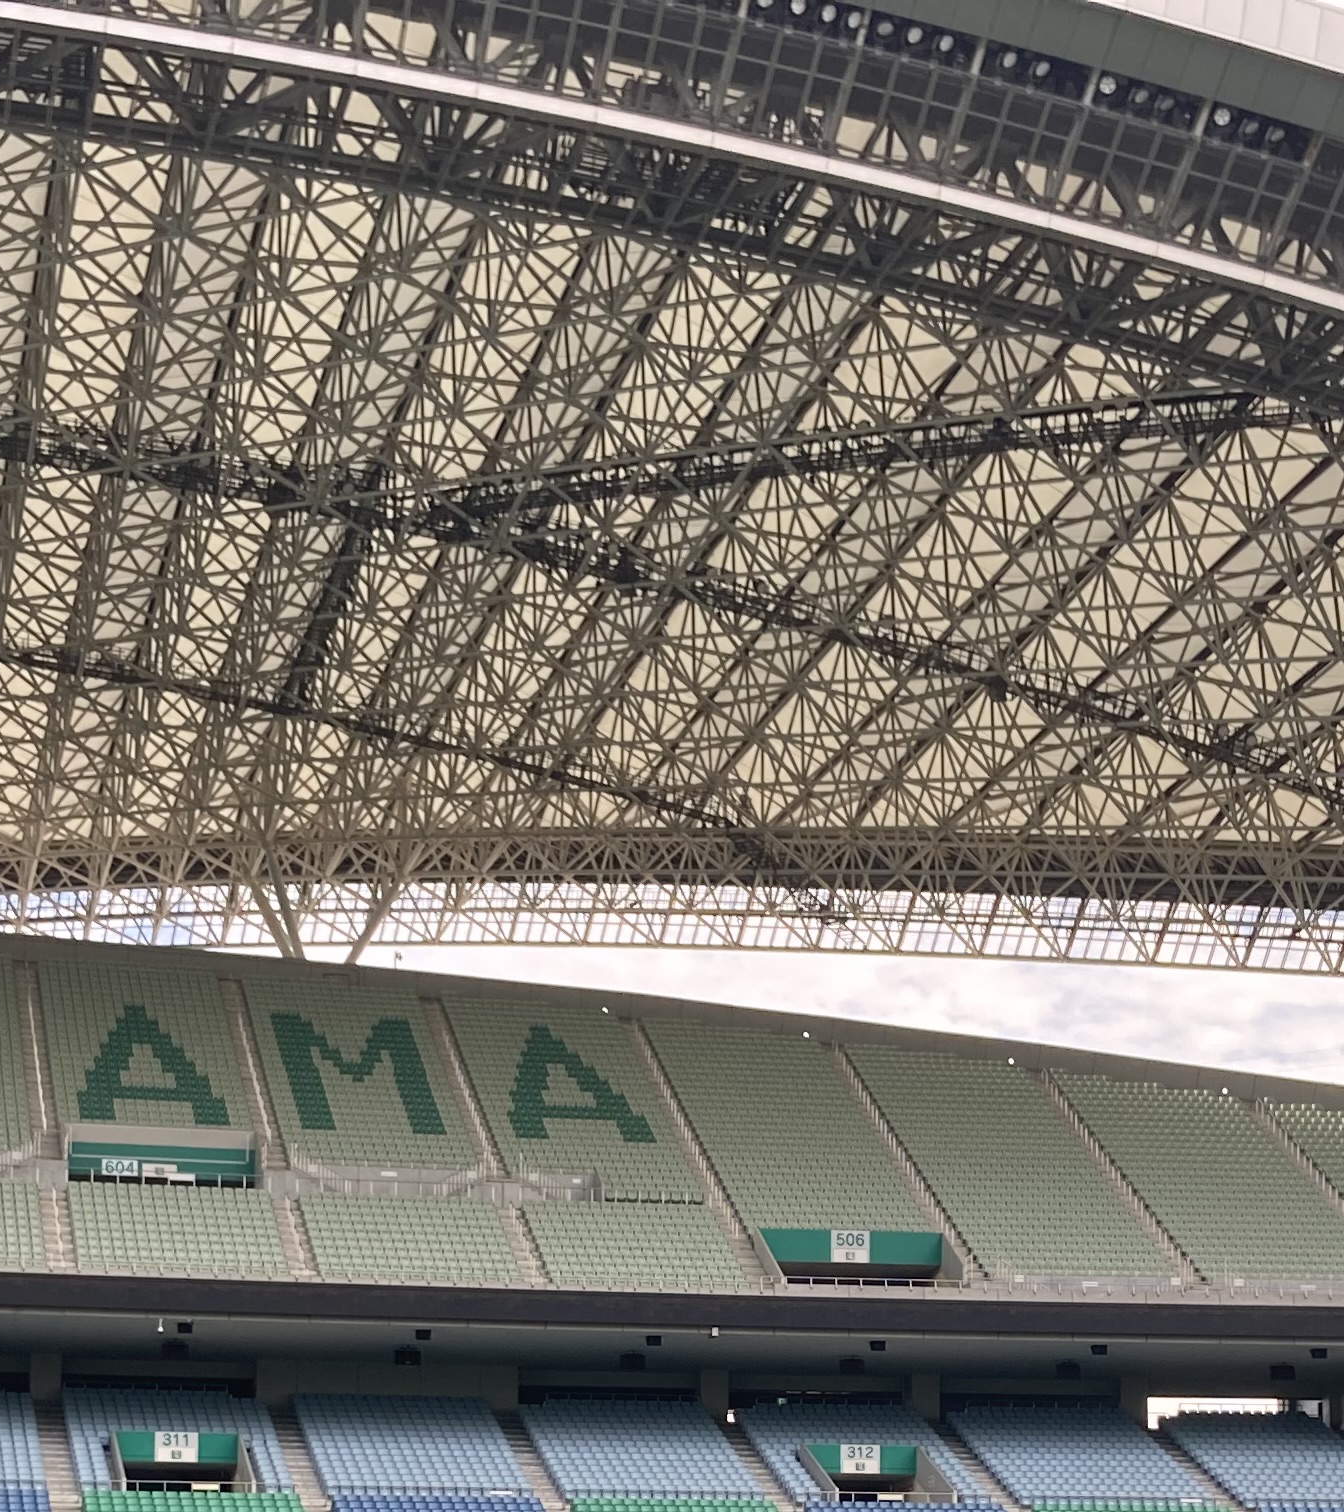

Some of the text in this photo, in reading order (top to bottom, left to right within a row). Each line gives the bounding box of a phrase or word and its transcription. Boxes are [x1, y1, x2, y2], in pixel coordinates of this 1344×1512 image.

[105, 1160, 136, 1174] 604
[836, 1232, 865, 1247] 506
[162, 1433, 189, 1447] 311
[847, 1445, 874, 1459] 312
